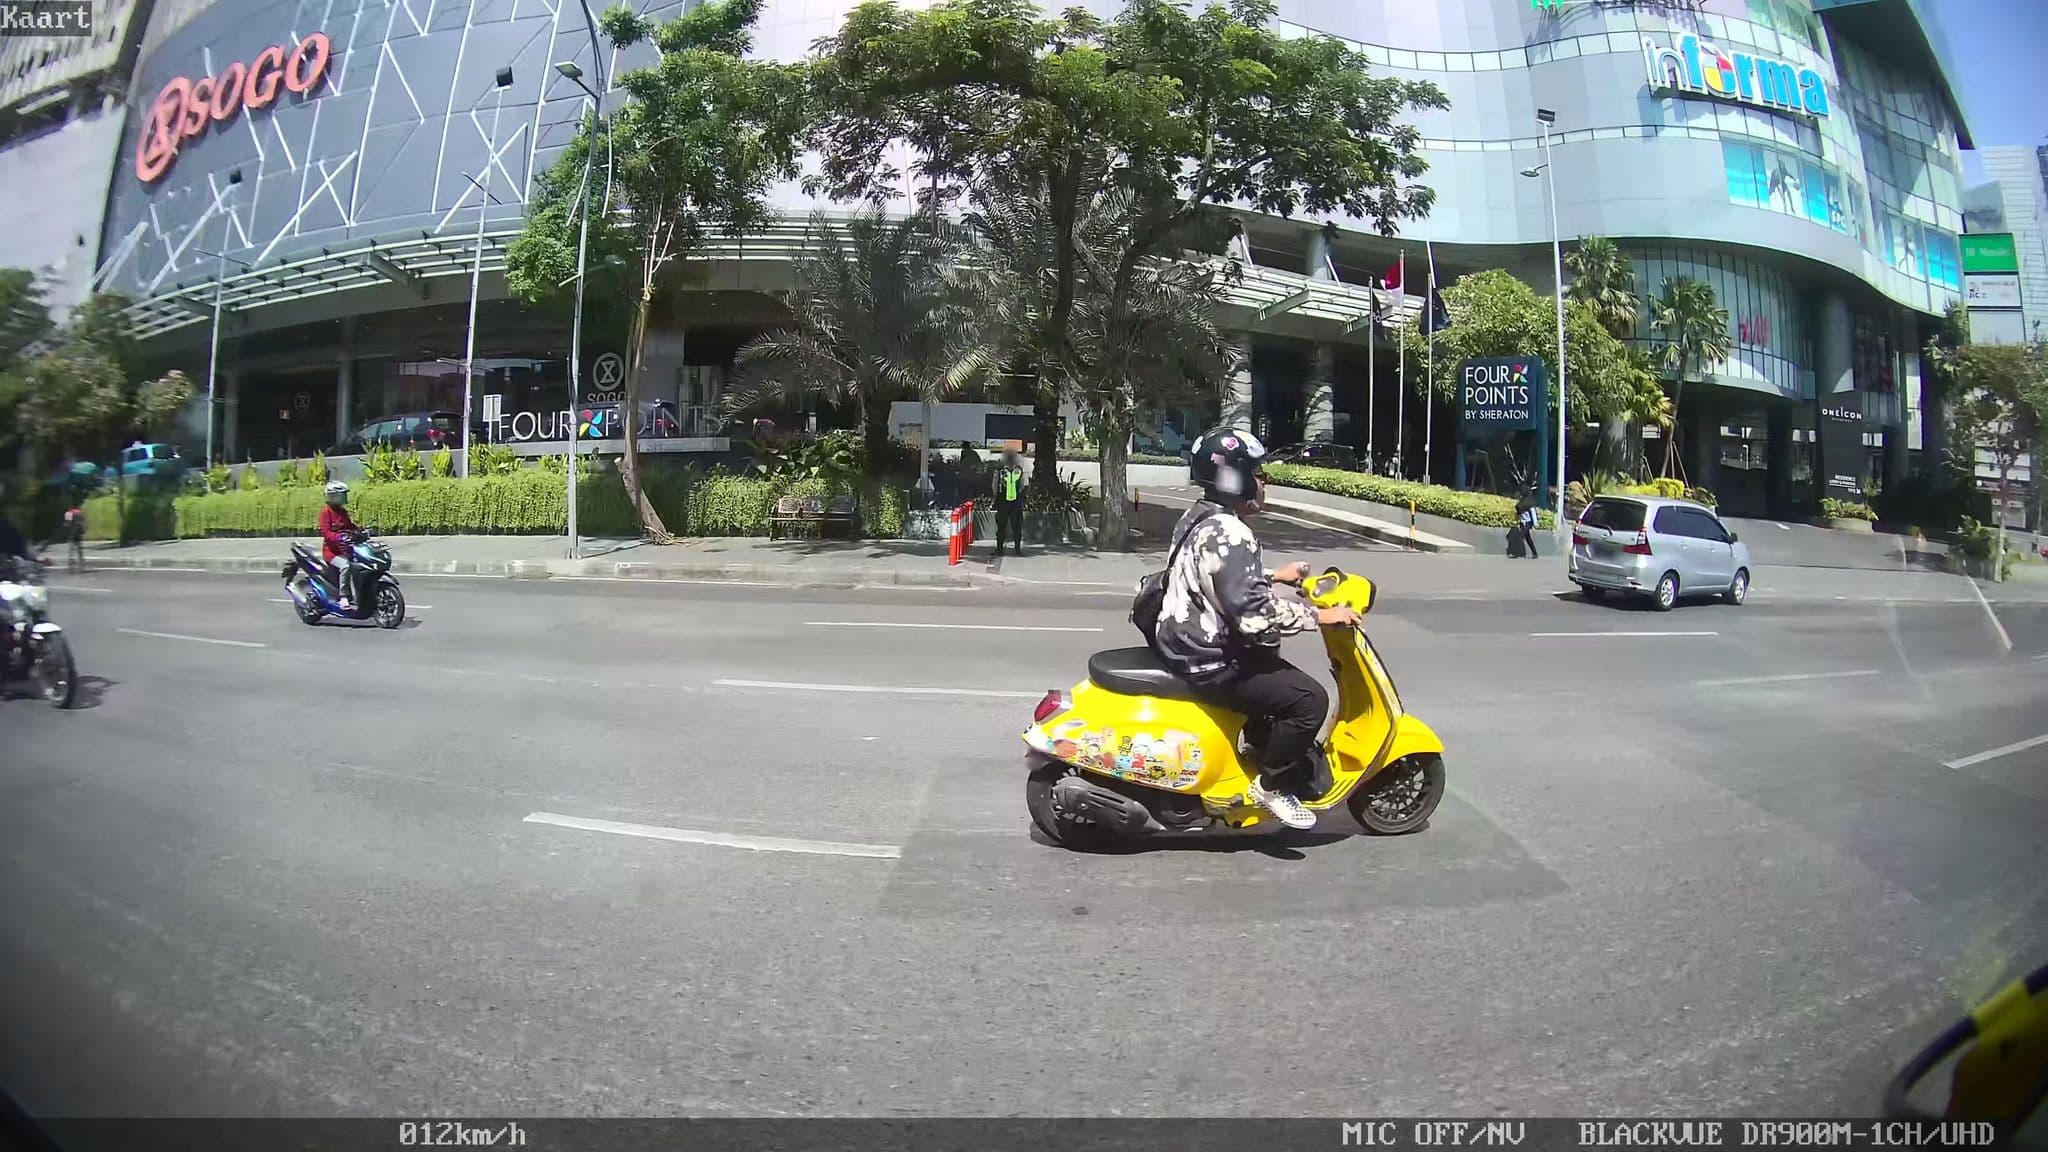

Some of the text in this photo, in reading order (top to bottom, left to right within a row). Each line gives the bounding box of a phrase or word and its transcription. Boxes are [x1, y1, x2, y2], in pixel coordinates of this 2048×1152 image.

[183, 31, 331, 135] SOGO
[1641, 33, 1831, 119] informa
[1465, 365, 1511, 385] FOUR
[1465, 386, 1529, 405] POINTS
[1465, 409, 1529, 420] BY SHERATON
